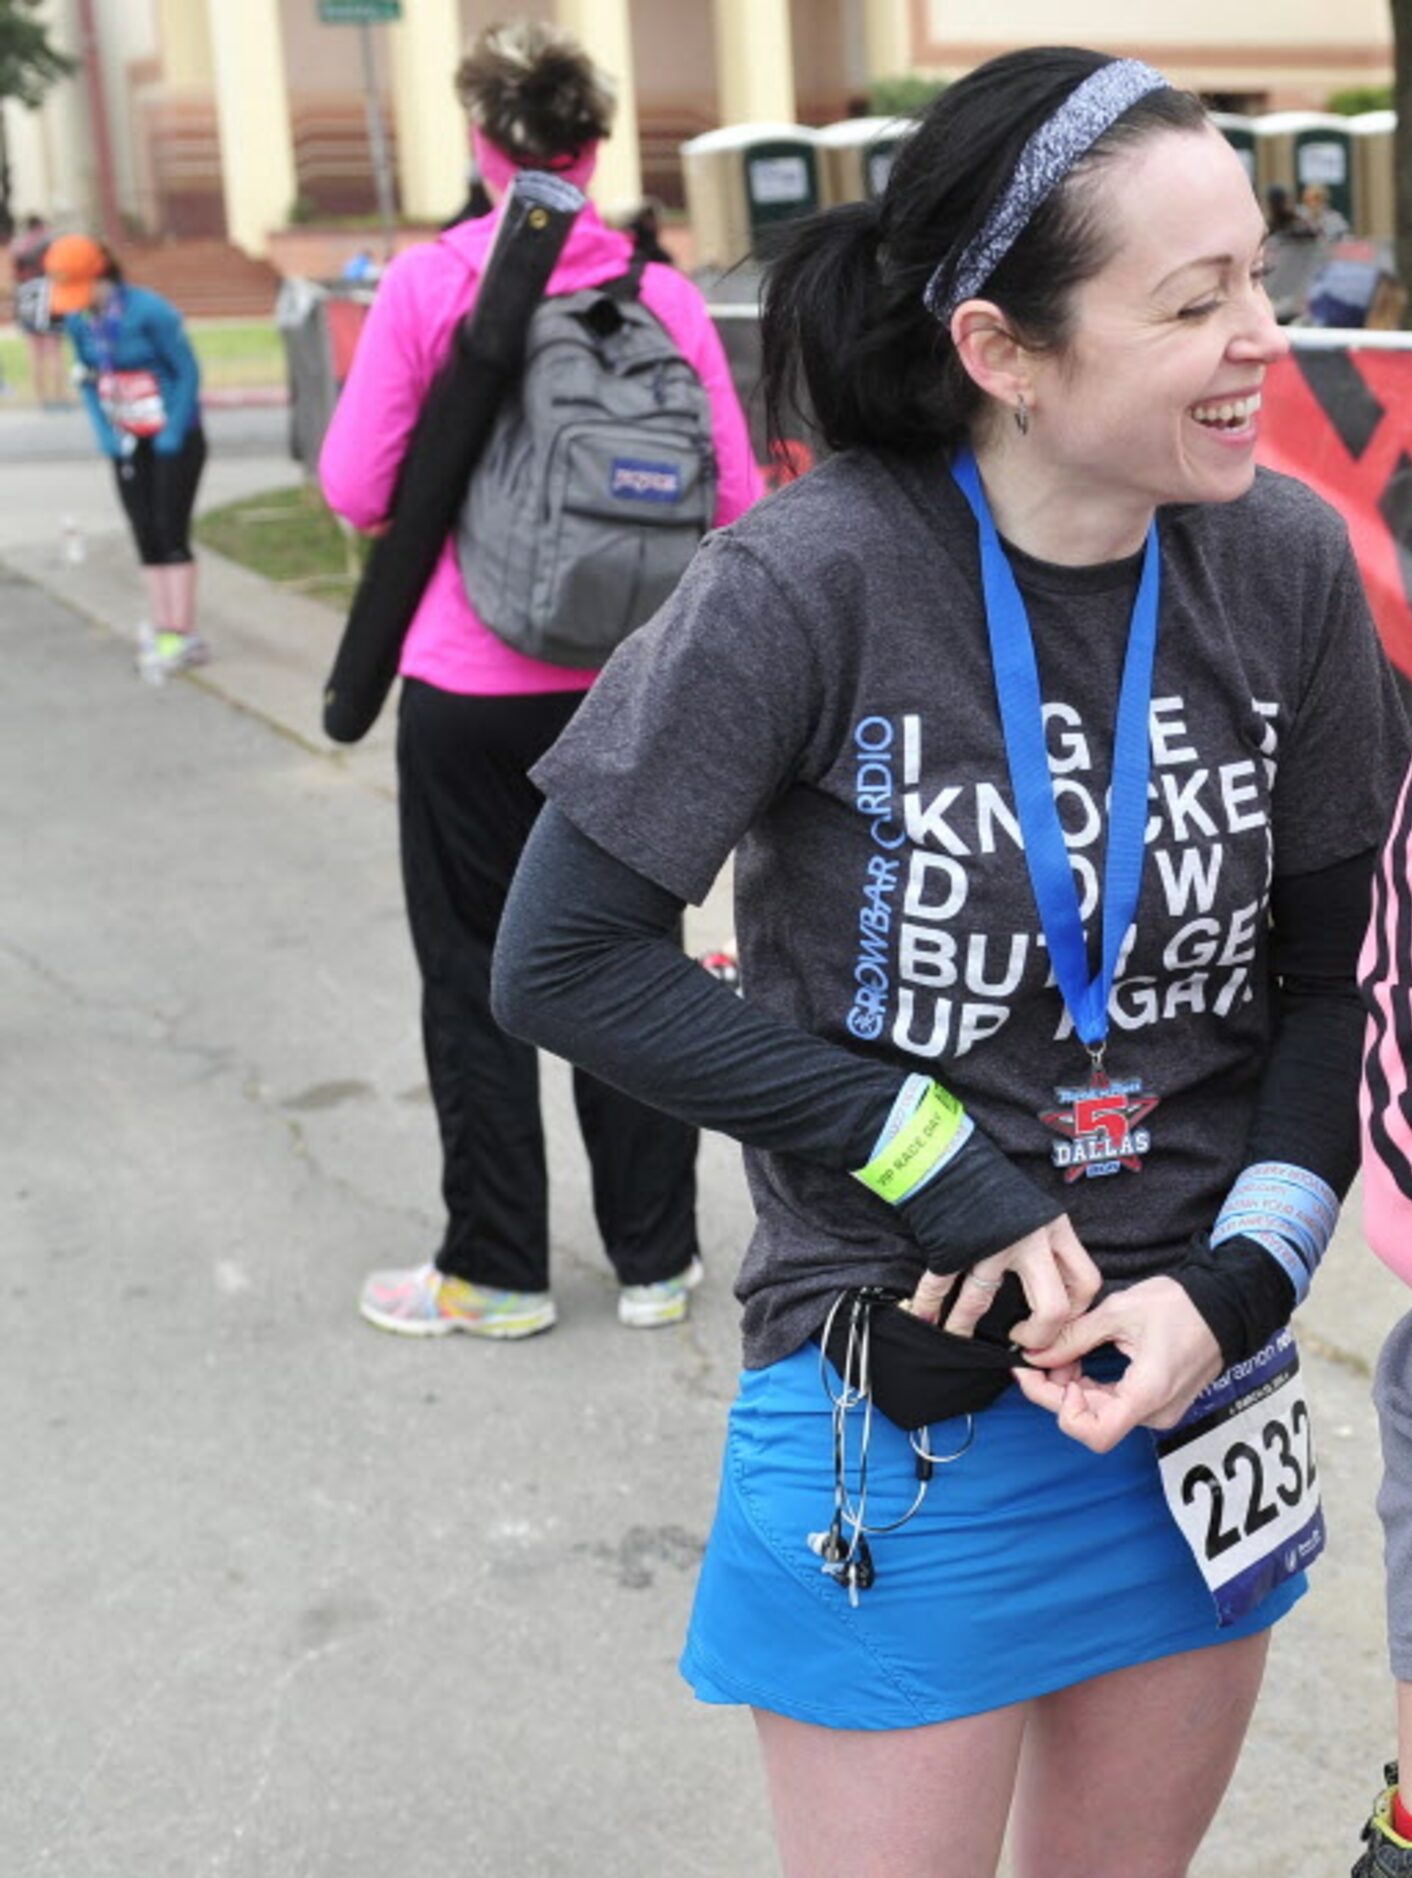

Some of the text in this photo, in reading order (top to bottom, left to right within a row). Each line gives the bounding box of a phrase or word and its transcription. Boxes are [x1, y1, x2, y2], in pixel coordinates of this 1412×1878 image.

[854, 715, 906, 849] CRDIO
[903, 714, 921, 785] I
[1162, 899, 1274, 971] GE
[891, 987, 1011, 1059] UP
[923, 1111, 942, 1138] DAY
[1053, 1129, 1151, 1167] DALLAS
[1074, 1095, 1129, 1148] 5
